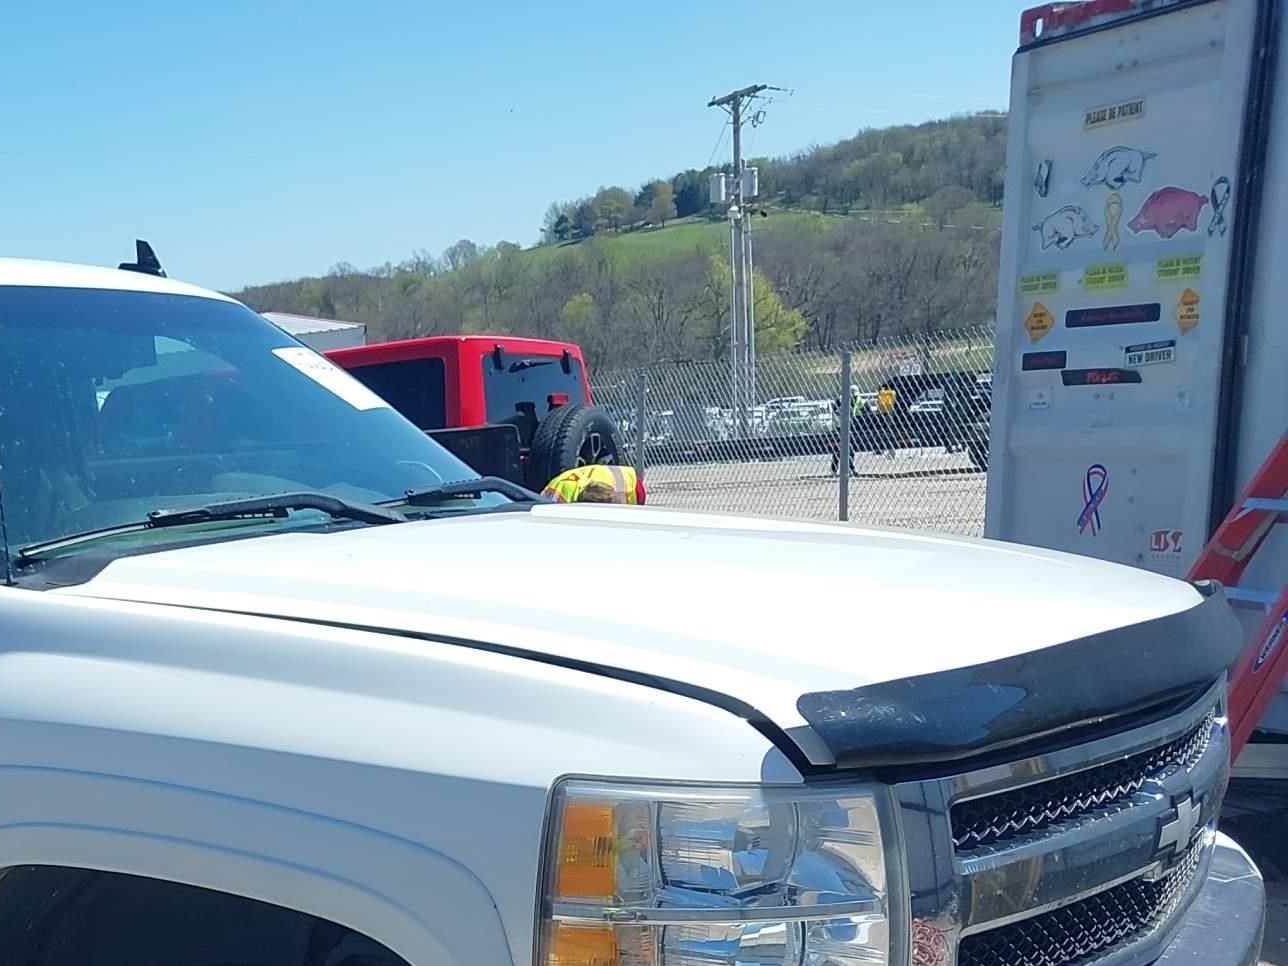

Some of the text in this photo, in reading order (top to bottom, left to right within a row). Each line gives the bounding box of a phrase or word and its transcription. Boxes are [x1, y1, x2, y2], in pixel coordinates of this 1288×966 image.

[1118, 101, 1144, 118] PATIENT
[1128, 349, 1172, 365] NEW DRIVER
